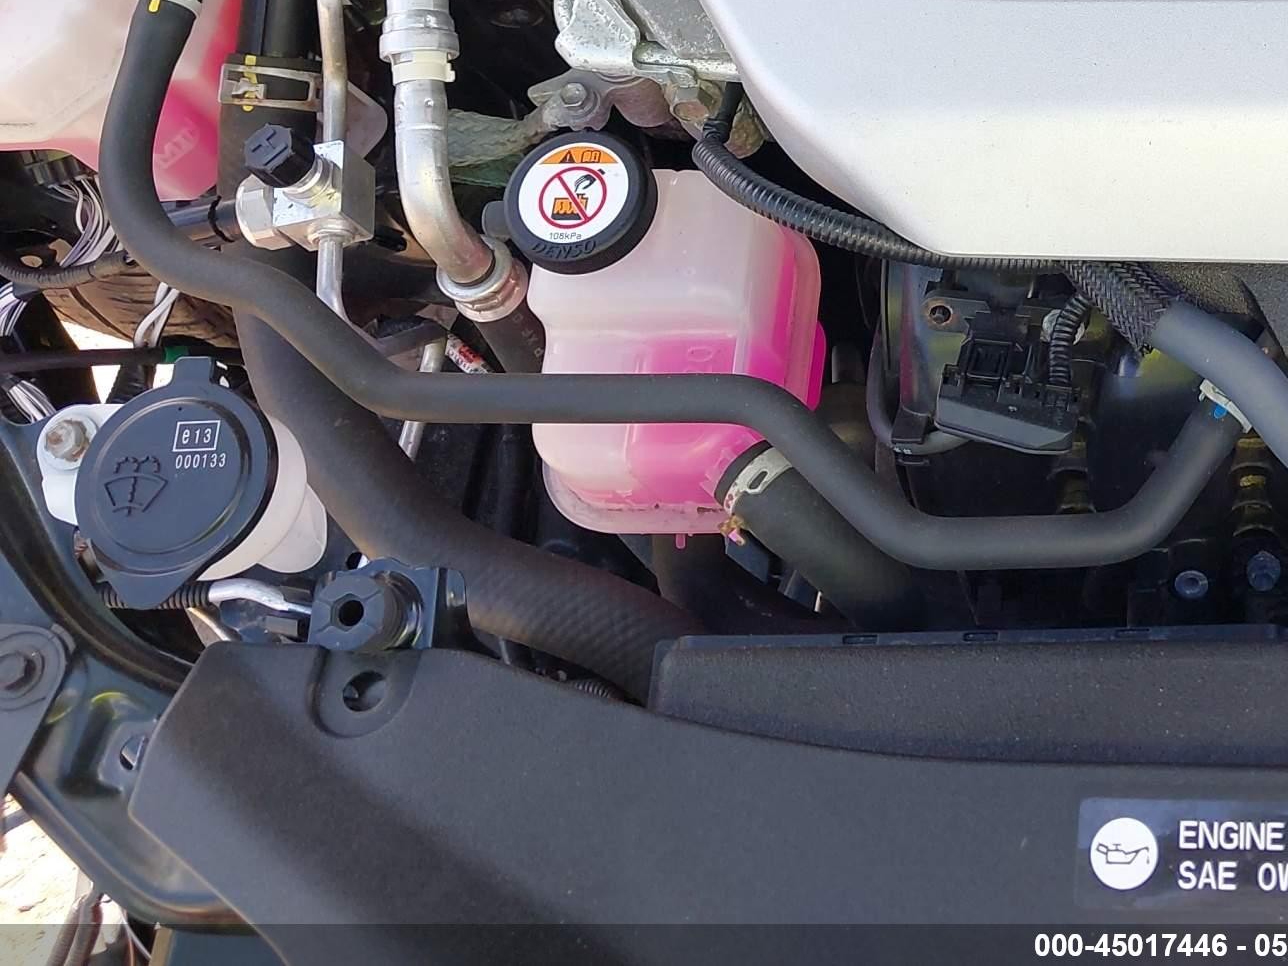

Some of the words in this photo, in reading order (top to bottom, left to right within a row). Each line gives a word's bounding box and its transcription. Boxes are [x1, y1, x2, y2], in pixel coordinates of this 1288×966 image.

[532, 241, 597, 259] DENSO
[182, 428, 212, 444] e13
[175, 453, 227, 469] 000133
[1178, 820, 1285, 851] ENGINE
[1178, 860, 1237, 890] SAE
